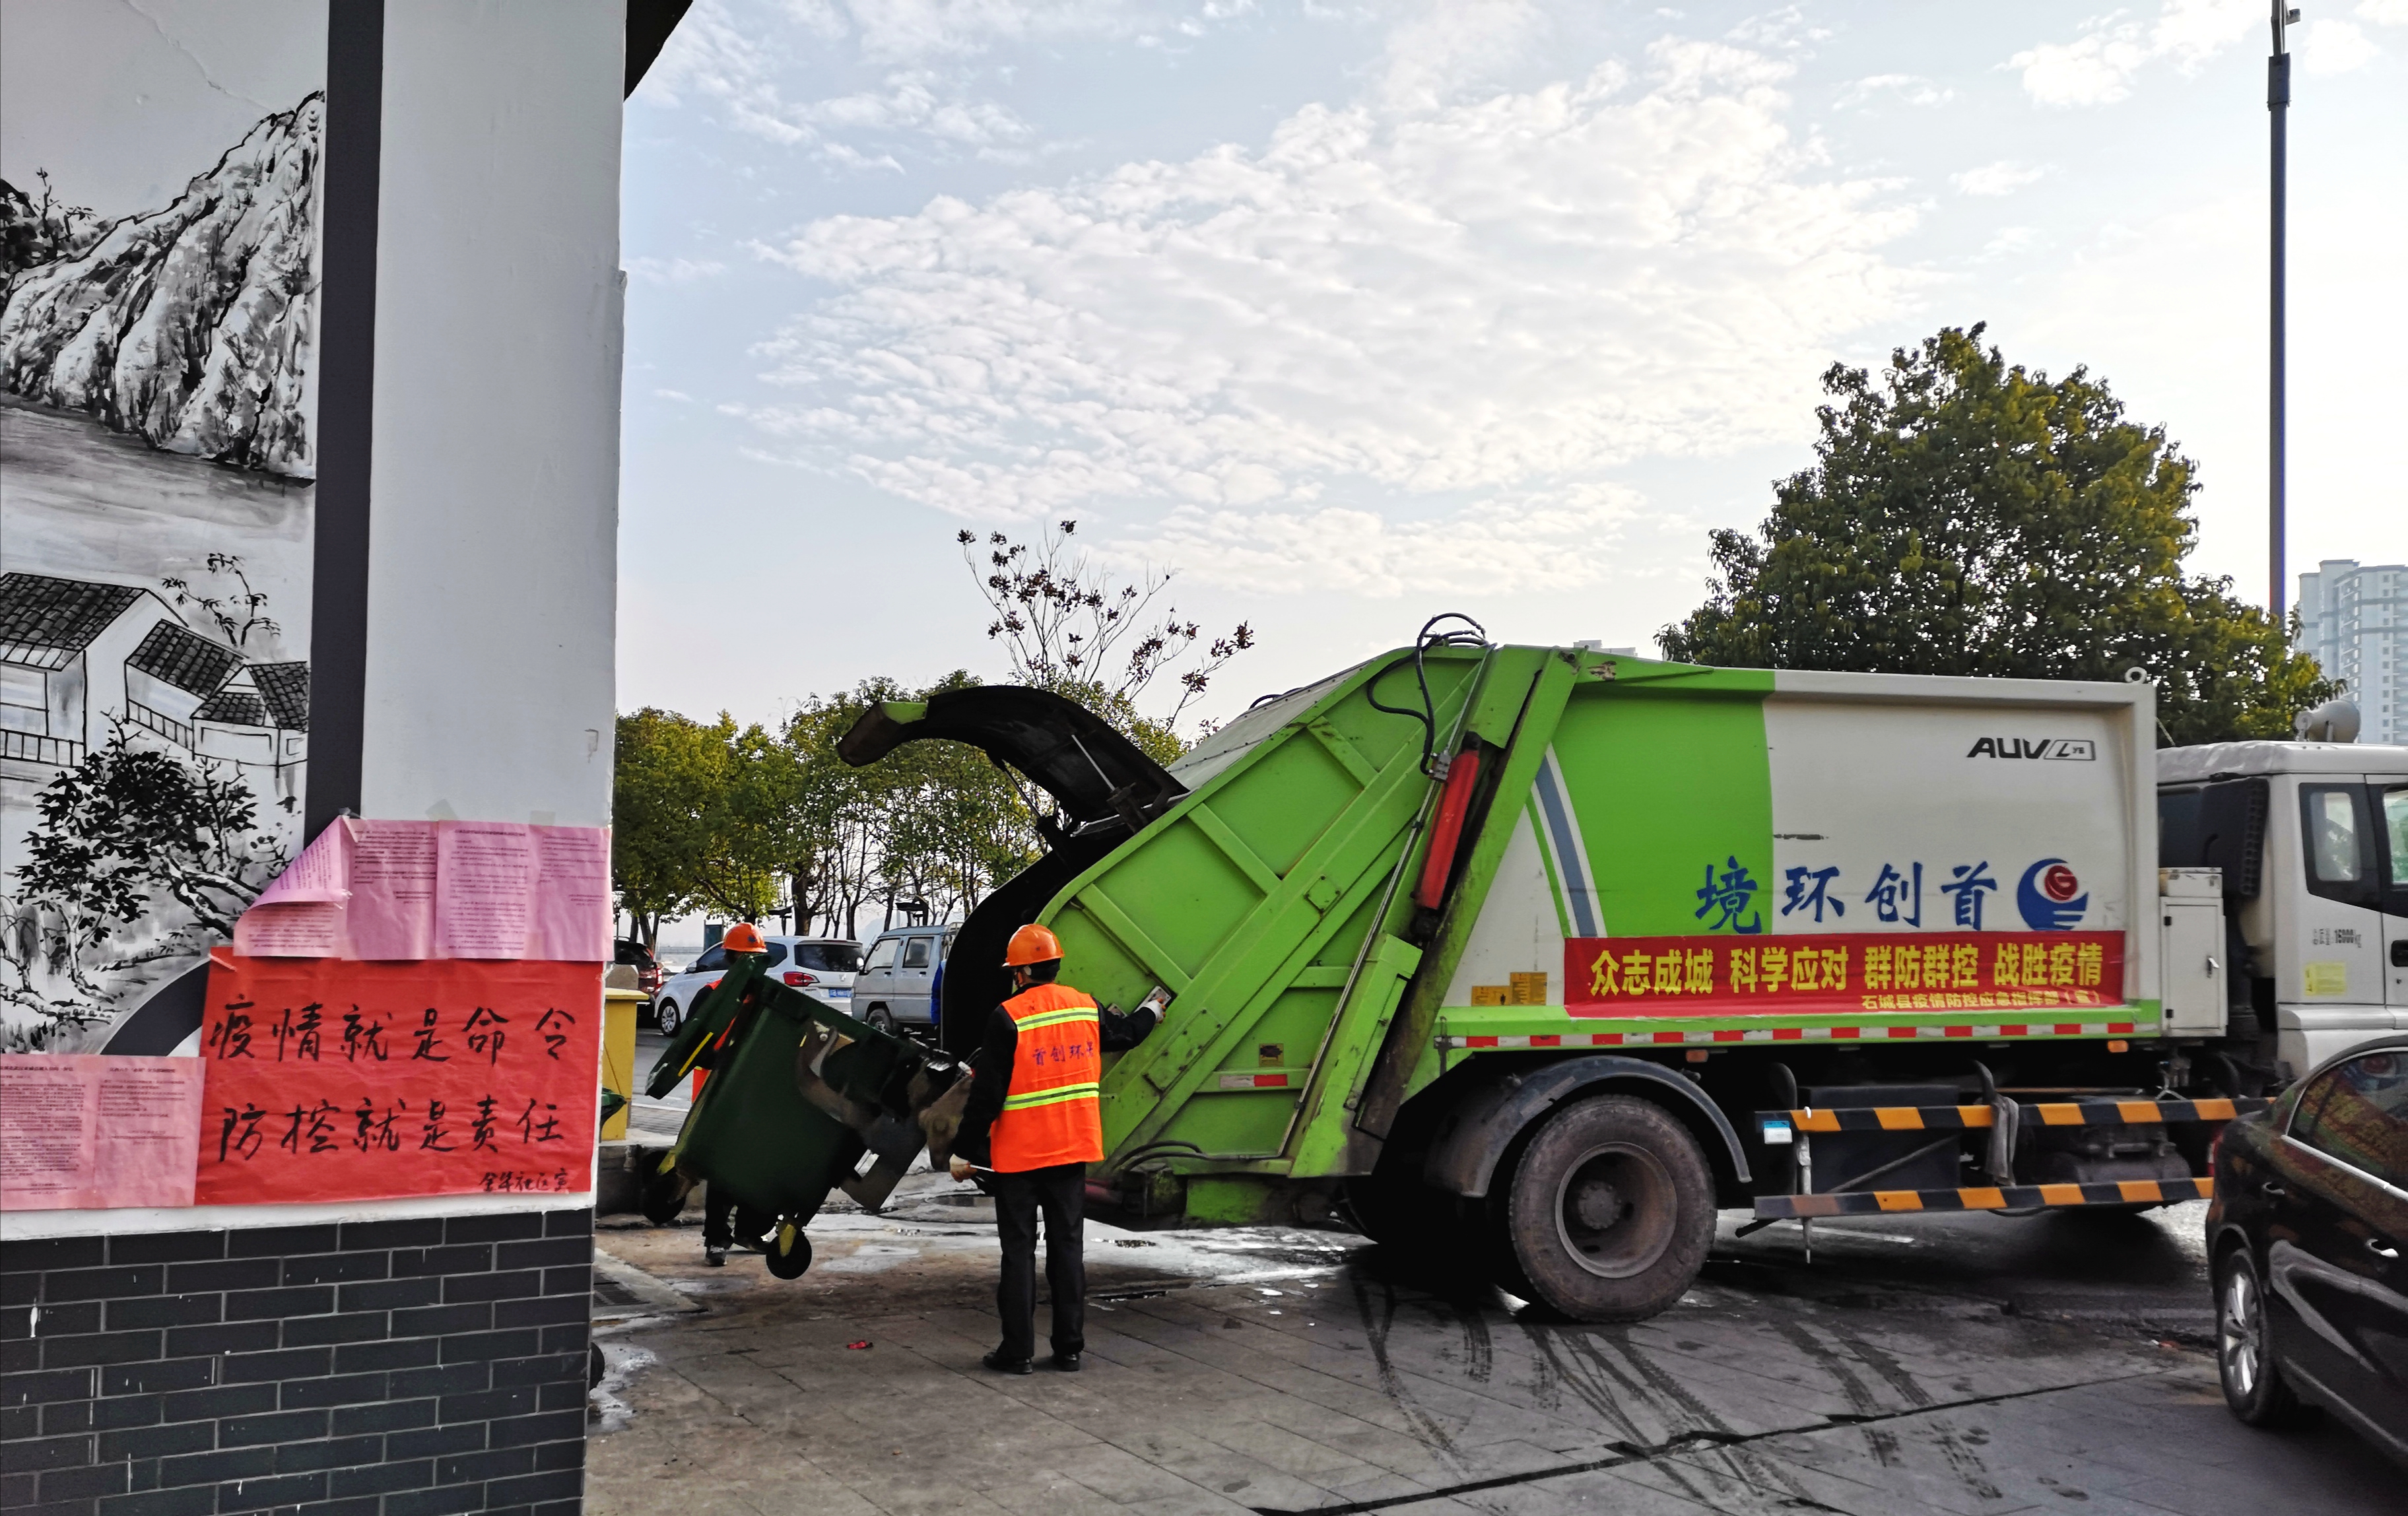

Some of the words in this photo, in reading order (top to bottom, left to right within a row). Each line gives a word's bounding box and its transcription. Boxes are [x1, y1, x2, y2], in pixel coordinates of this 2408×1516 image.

[1966, 737, 2051, 759] AUV
[1590, 947, 1714, 996] 众志成城
[1730, 946, 1849, 992] 科学应对
[1864, 943, 1980, 989] 群防群控
[1993, 942, 2103, 987] 战胜疫情
[209, 993, 576, 1067] 疫情就是命令
[219, 1094, 565, 1162] 防控就是责任
